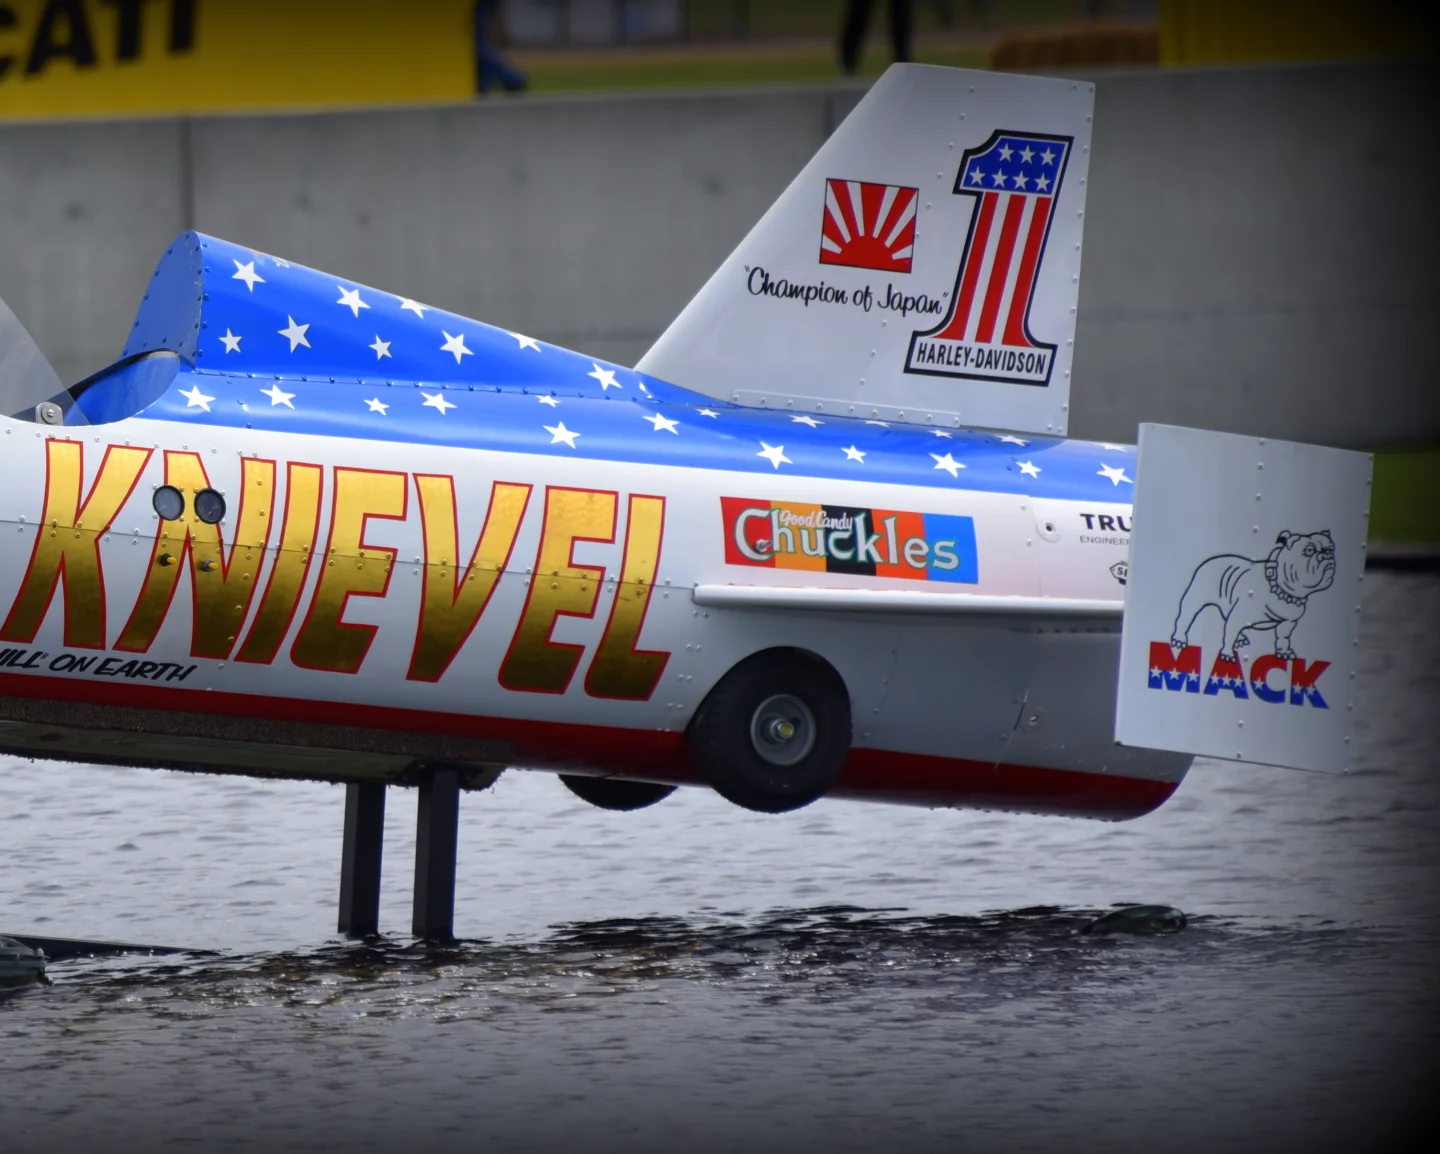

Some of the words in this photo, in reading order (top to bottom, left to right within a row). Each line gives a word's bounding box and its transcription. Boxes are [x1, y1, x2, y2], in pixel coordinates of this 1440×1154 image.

[852, 285, 874, 312] of
[916, 342, 1047, 375] HARLEY-DAVIDSON
[734, 508, 960, 571] Chuckles
[48, 653, 98, 673] ON
[98, 658, 197, 682] EARTH
[1147, 640, 1333, 709] MACK
